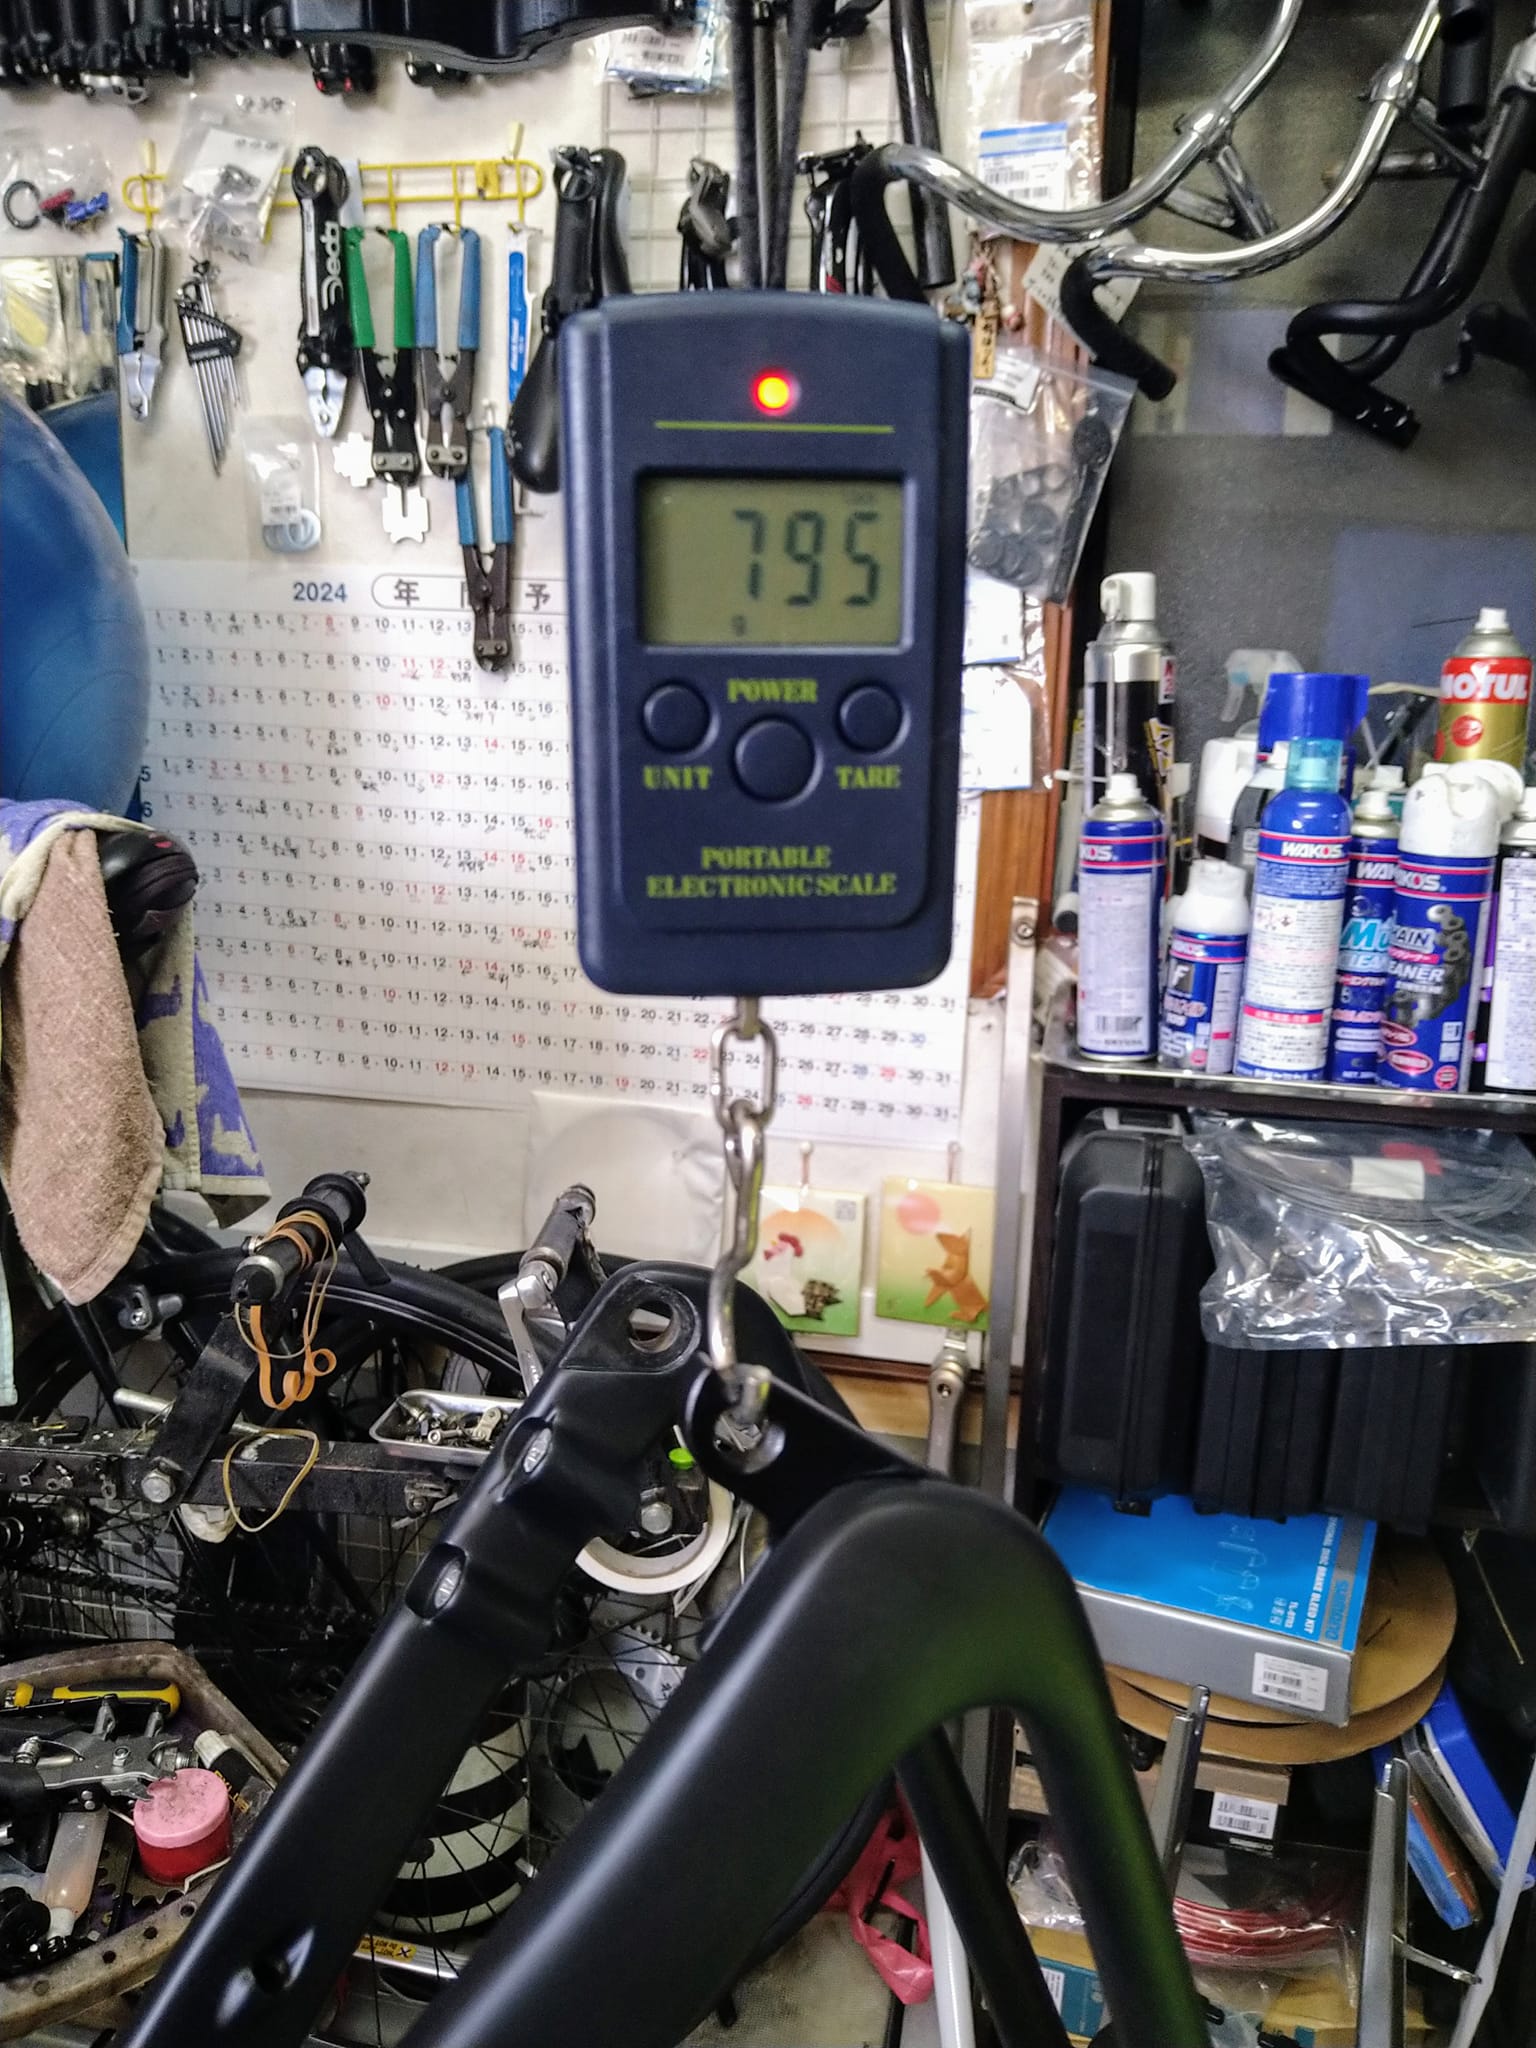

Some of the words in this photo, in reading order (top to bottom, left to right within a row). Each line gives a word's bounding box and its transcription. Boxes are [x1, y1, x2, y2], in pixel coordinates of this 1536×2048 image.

[320, 220, 343, 311] Deda
[733, 509, 880, 608] 795
[293, 582, 348, 602] 2024
[394, 578, 420, 607] 年
[525, 582, 551, 611] 予
[375, 618, 390, 629] 10
[402, 619, 415, 630] 11
[430, 620, 444, 631] 12
[456, 621, 471, 632] 13
[511, 623, 526, 634] 15
[538, 624, 553, 635] 16
[376, 657, 390, 668] 10
[403, 658, 418, 669] 11
[430, 659, 444, 670] 12
[457, 660, 471, 671] 13
[511, 662, 526, 673] 15
[539, 663, 553, 674] 16
[727, 679, 818, 703] POWER
[376, 694, 390, 705] 10
[404, 696, 417, 707] 11
[430, 697, 444, 708] 12
[457, 698, 471, 709] 13
[484, 699, 498, 710] 14
[512, 701, 525, 712] 15
[539, 702, 552, 713] 16
[377, 732, 391, 743] 10
[404, 734, 417, 745] 11
[430, 735, 444, 746] 12
[457, 737, 471, 748] 13
[485, 738, 498, 749] 14
[512, 739, 526, 750] 15
[539, 741, 553, 752] 16
[377, 770, 391, 781] 10
[404, 772, 418, 783] 11
[430, 773, 444, 784] 12
[457, 775, 471, 786] 13
[484, 776, 498, 787] 14
[512, 778, 526, 789] 15
[539, 779, 552, 790] 16
[643, 765, 713, 790] UNIT
[836, 765, 901, 789] TARE
[378, 807, 392, 818] 10
[405, 809, 418, 820] 11
[430, 811, 445, 822] 12
[457, 813, 471, 824] 13
[484, 814, 498, 825] 14
[511, 816, 525, 827] 15
[538, 817, 552, 828] 16
[379, 844, 392, 855] 10
[406, 846, 419, 857] 11
[431, 848, 444, 859] 12
[457, 850, 472, 861] 13
[484, 852, 499, 863] 14
[511, 853, 525, 864] 15
[538, 854, 552, 865] 16
[701, 846, 832, 869] PORTABLE
[380, 881, 393, 892] 10
[406, 883, 420, 894] 11
[432, 885, 445, 896] 12
[458, 886, 471, 897] 13
[484, 888, 498, 899] 14
[511, 890, 525, 901] 15
[538, 892, 552, 903] 16
[647, 875, 813, 898] ELECTRONIC
[816, 873, 897, 896] SCALE
[381, 917, 394, 928] 10
[407, 919, 420, 930] 11
[432, 921, 445, 932] 12
[458, 923, 471, 934] 13
[484, 925, 499, 936] 14
[511, 927, 525, 938] 15
[537, 928, 552, 939] 16
[382, 953, 395, 964] 10
[408, 955, 421, 966] 11
[433, 957, 446, 968] 12
[459, 959, 472, 970] 13
[485, 961, 498, 972] 14
[511, 963, 524, 974] 15
[537, 965, 551, 976] 16
[562, 967, 578, 978] 17
[383, 988, 396, 999] 10
[408, 990, 421, 1001] 11
[434, 992, 447, 1003] 12
[460, 994, 473, 1005] 13
[485, 996, 498, 1007] 14
[511, 998, 524, 1009] 15
[537, 1000, 551, 1011] 16
[563, 1003, 577, 1014] 17
[589, 1004, 603, 1015] 18
[616, 1006, 630, 1017] 19
[641, 1008, 656, 1019] 20
[667, 1010, 681, 1021] 21
[384, 1023, 397, 1034] 10
[409, 1025, 422, 1036] 11
[435, 1027, 448, 1038] 12
[460, 1029, 473, 1040] 13
[486, 1031, 499, 1042] 14
[512, 1033, 525, 1044] 15
[538, 1035, 551, 1046] 16
[563, 1037, 576, 1048] 17
[589, 1040, 603, 1051] 18
[616, 1042, 629, 1053] 19
[640, 1044, 655, 1055] 20
[667, 1046, 680, 1057] 21
[384, 1058, 398, 1069] 10
[410, 1059, 423, 1070] 11
[435, 1061, 448, 1072] 12
[461, 1063, 474, 1074] 13
[485, 1065, 500, 1076] 14
[512, 1067, 526, 1078] 15
[538, 1069, 551, 1080] 16
[563, 1071, 578, 1082] 17
[590, 1075, 603, 1086] 18
[616, 1076, 629, 1087] 19
[640, 1079, 655, 1090] 20
[666, 1081, 679, 1092] 21
